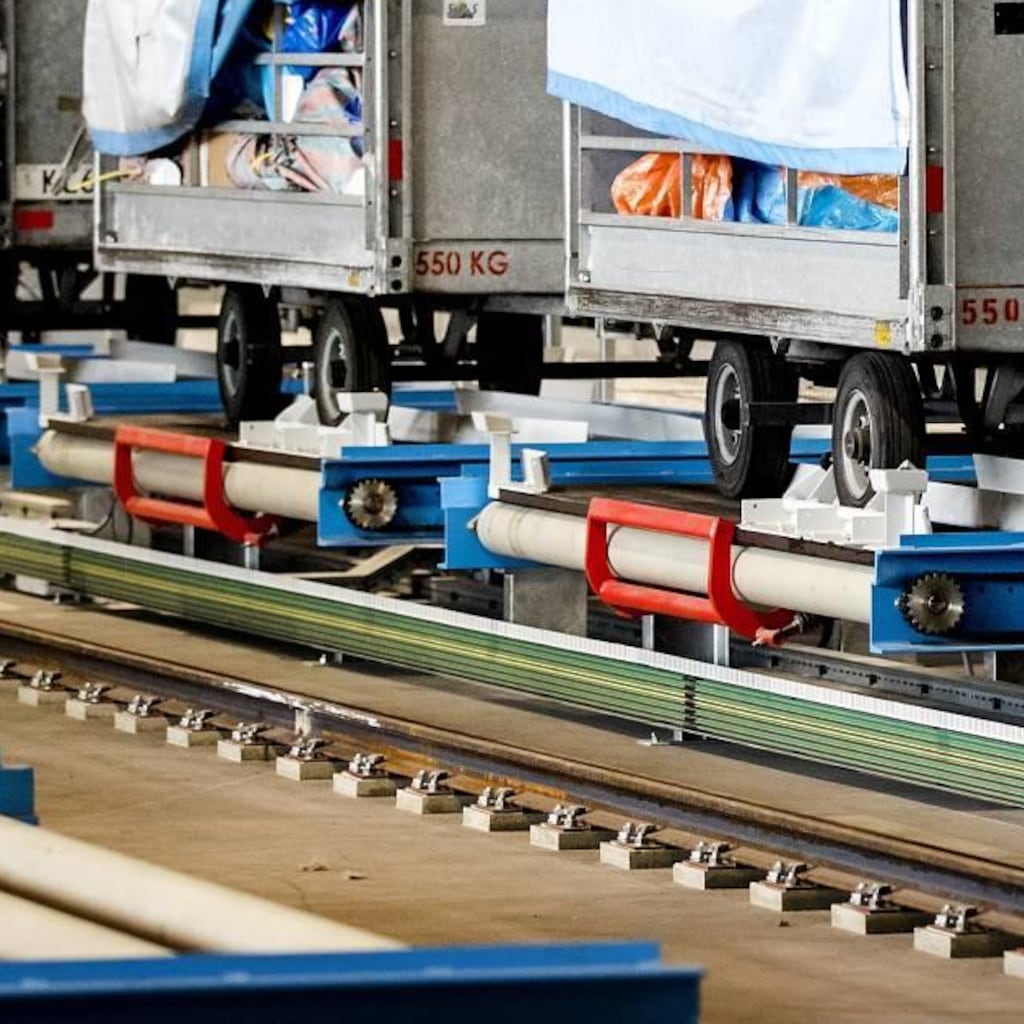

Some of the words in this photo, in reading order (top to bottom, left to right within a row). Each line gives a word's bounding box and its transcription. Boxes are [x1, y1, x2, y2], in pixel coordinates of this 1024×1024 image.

[415, 251, 461, 276] 550
[470, 251, 508, 276] KG
[962, 298, 1020, 325] 550
